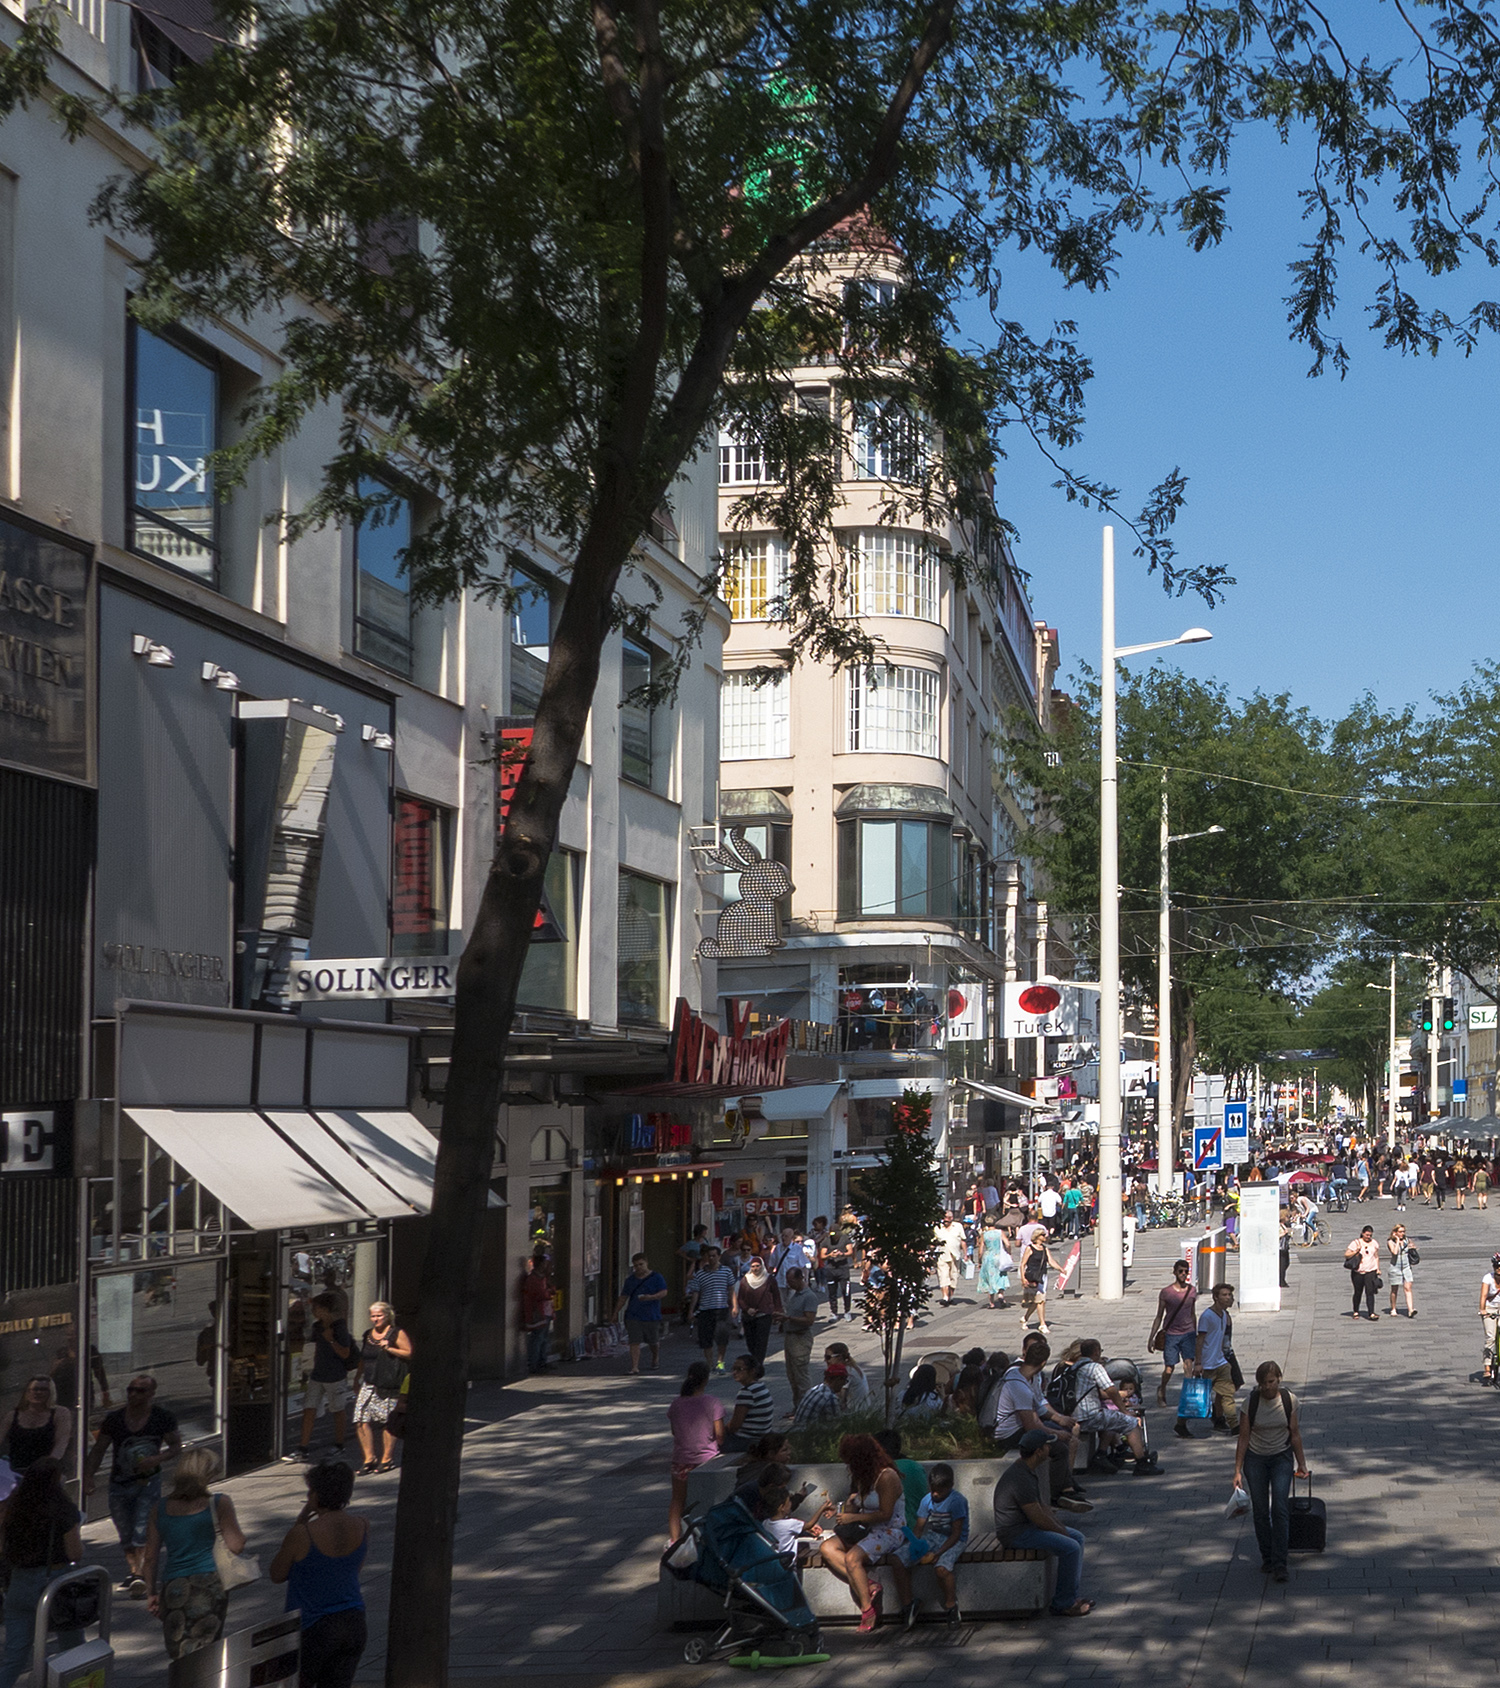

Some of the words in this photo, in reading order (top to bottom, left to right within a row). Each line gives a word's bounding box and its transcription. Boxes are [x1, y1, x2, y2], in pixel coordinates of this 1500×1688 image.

[296, 965, 452, 993] SOLINGER
[1013, 1019, 1065, 1035] Turek
[745, 1199, 799, 1215] SALE
